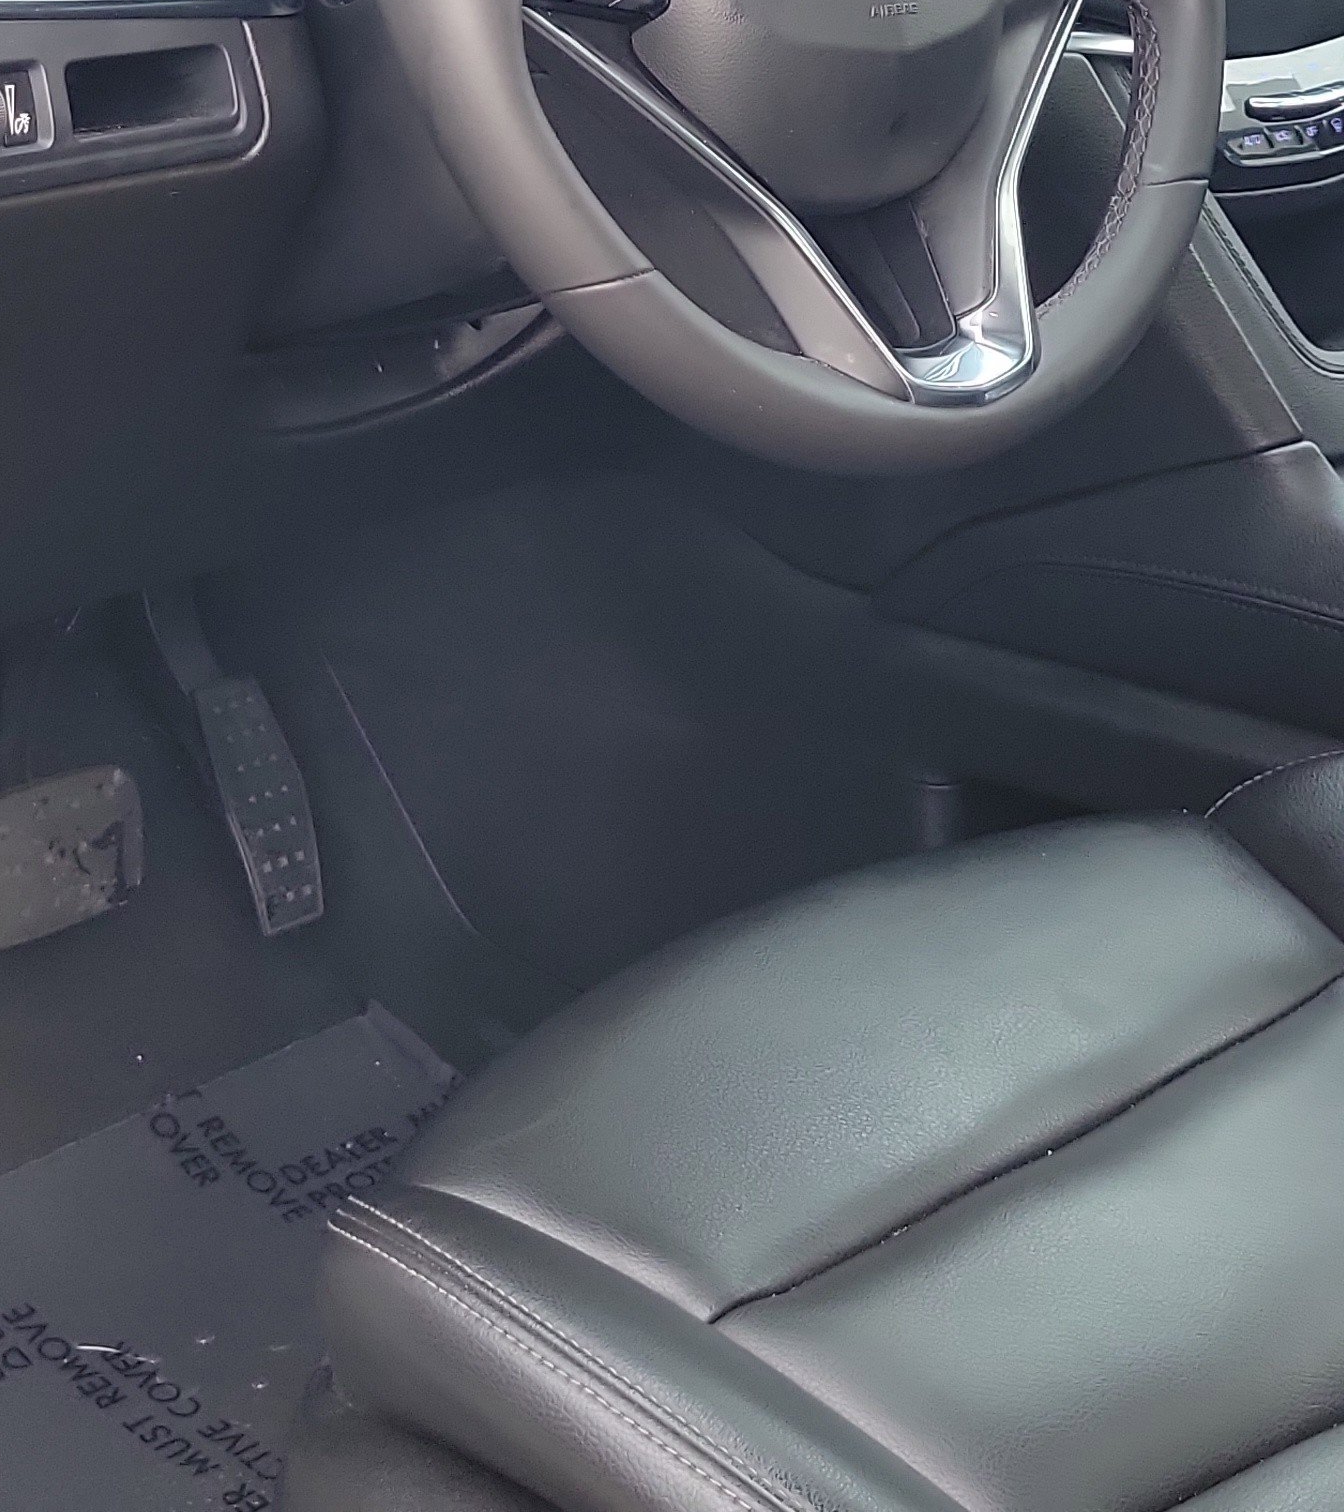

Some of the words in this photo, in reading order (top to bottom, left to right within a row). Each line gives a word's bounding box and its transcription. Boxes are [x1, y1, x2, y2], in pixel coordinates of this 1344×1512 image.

[197, 1116, 310, 1223] REMOVE
[2, 1302, 128, 1409] REMOVE
[102, 1341, 202, 1418] COVER
[122, 1415, 221, 1477] MUST
